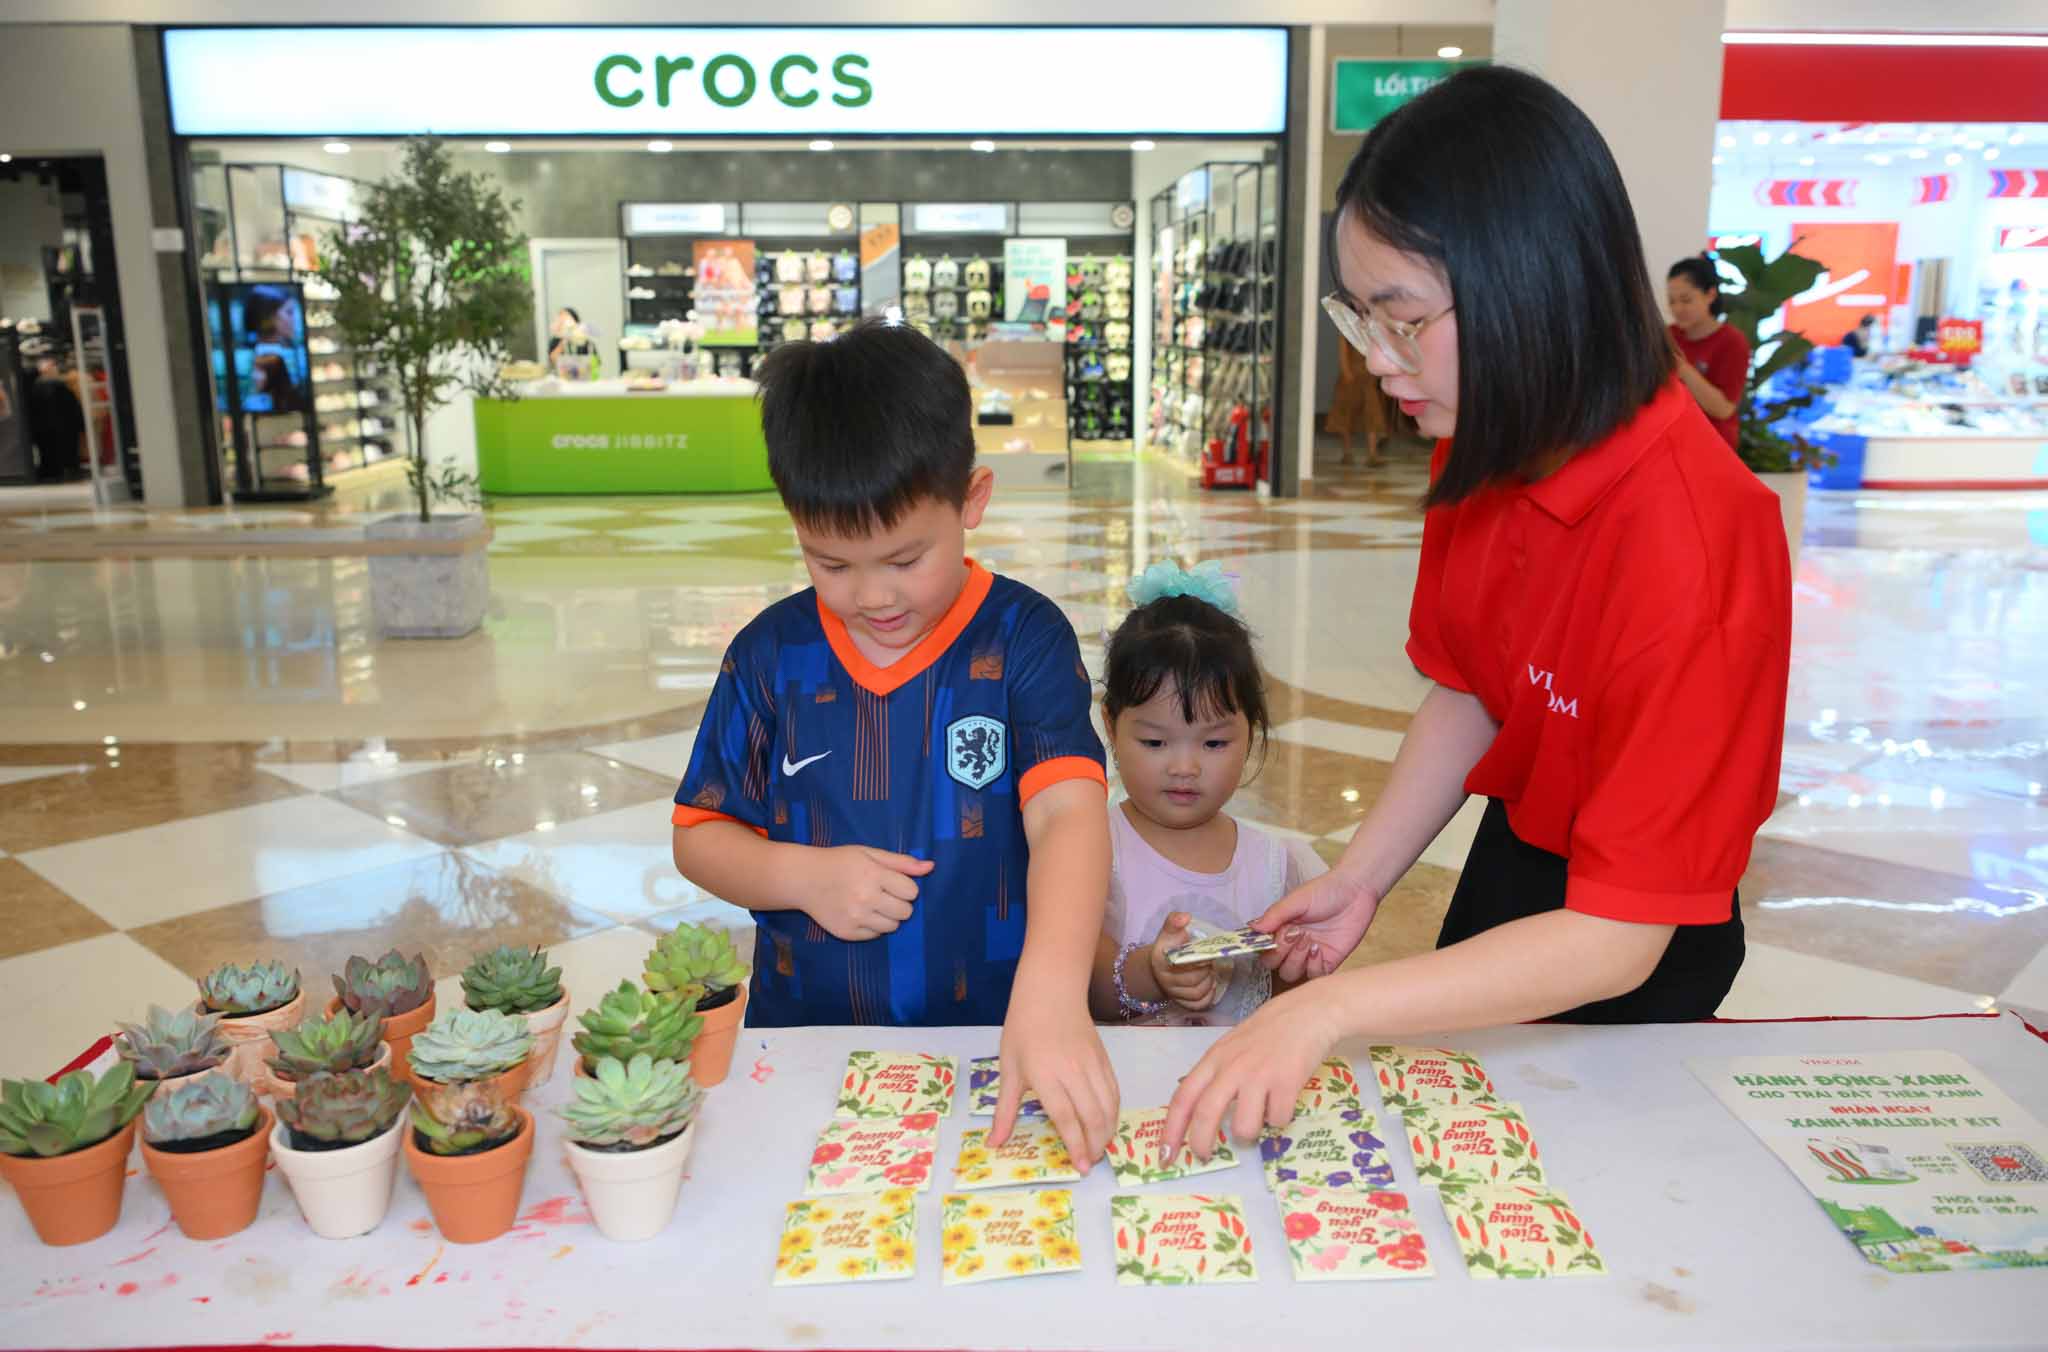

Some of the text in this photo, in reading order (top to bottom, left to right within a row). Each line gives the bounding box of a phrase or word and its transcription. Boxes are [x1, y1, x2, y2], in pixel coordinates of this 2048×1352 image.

[594, 54, 872, 108] crocs
[1894, 1074, 1971, 1086] XANH
[1748, 1090, 1784, 1098] CHO
[1934, 1089, 1984, 1098] XANH
[1964, 1117, 2002, 1128] KIT
